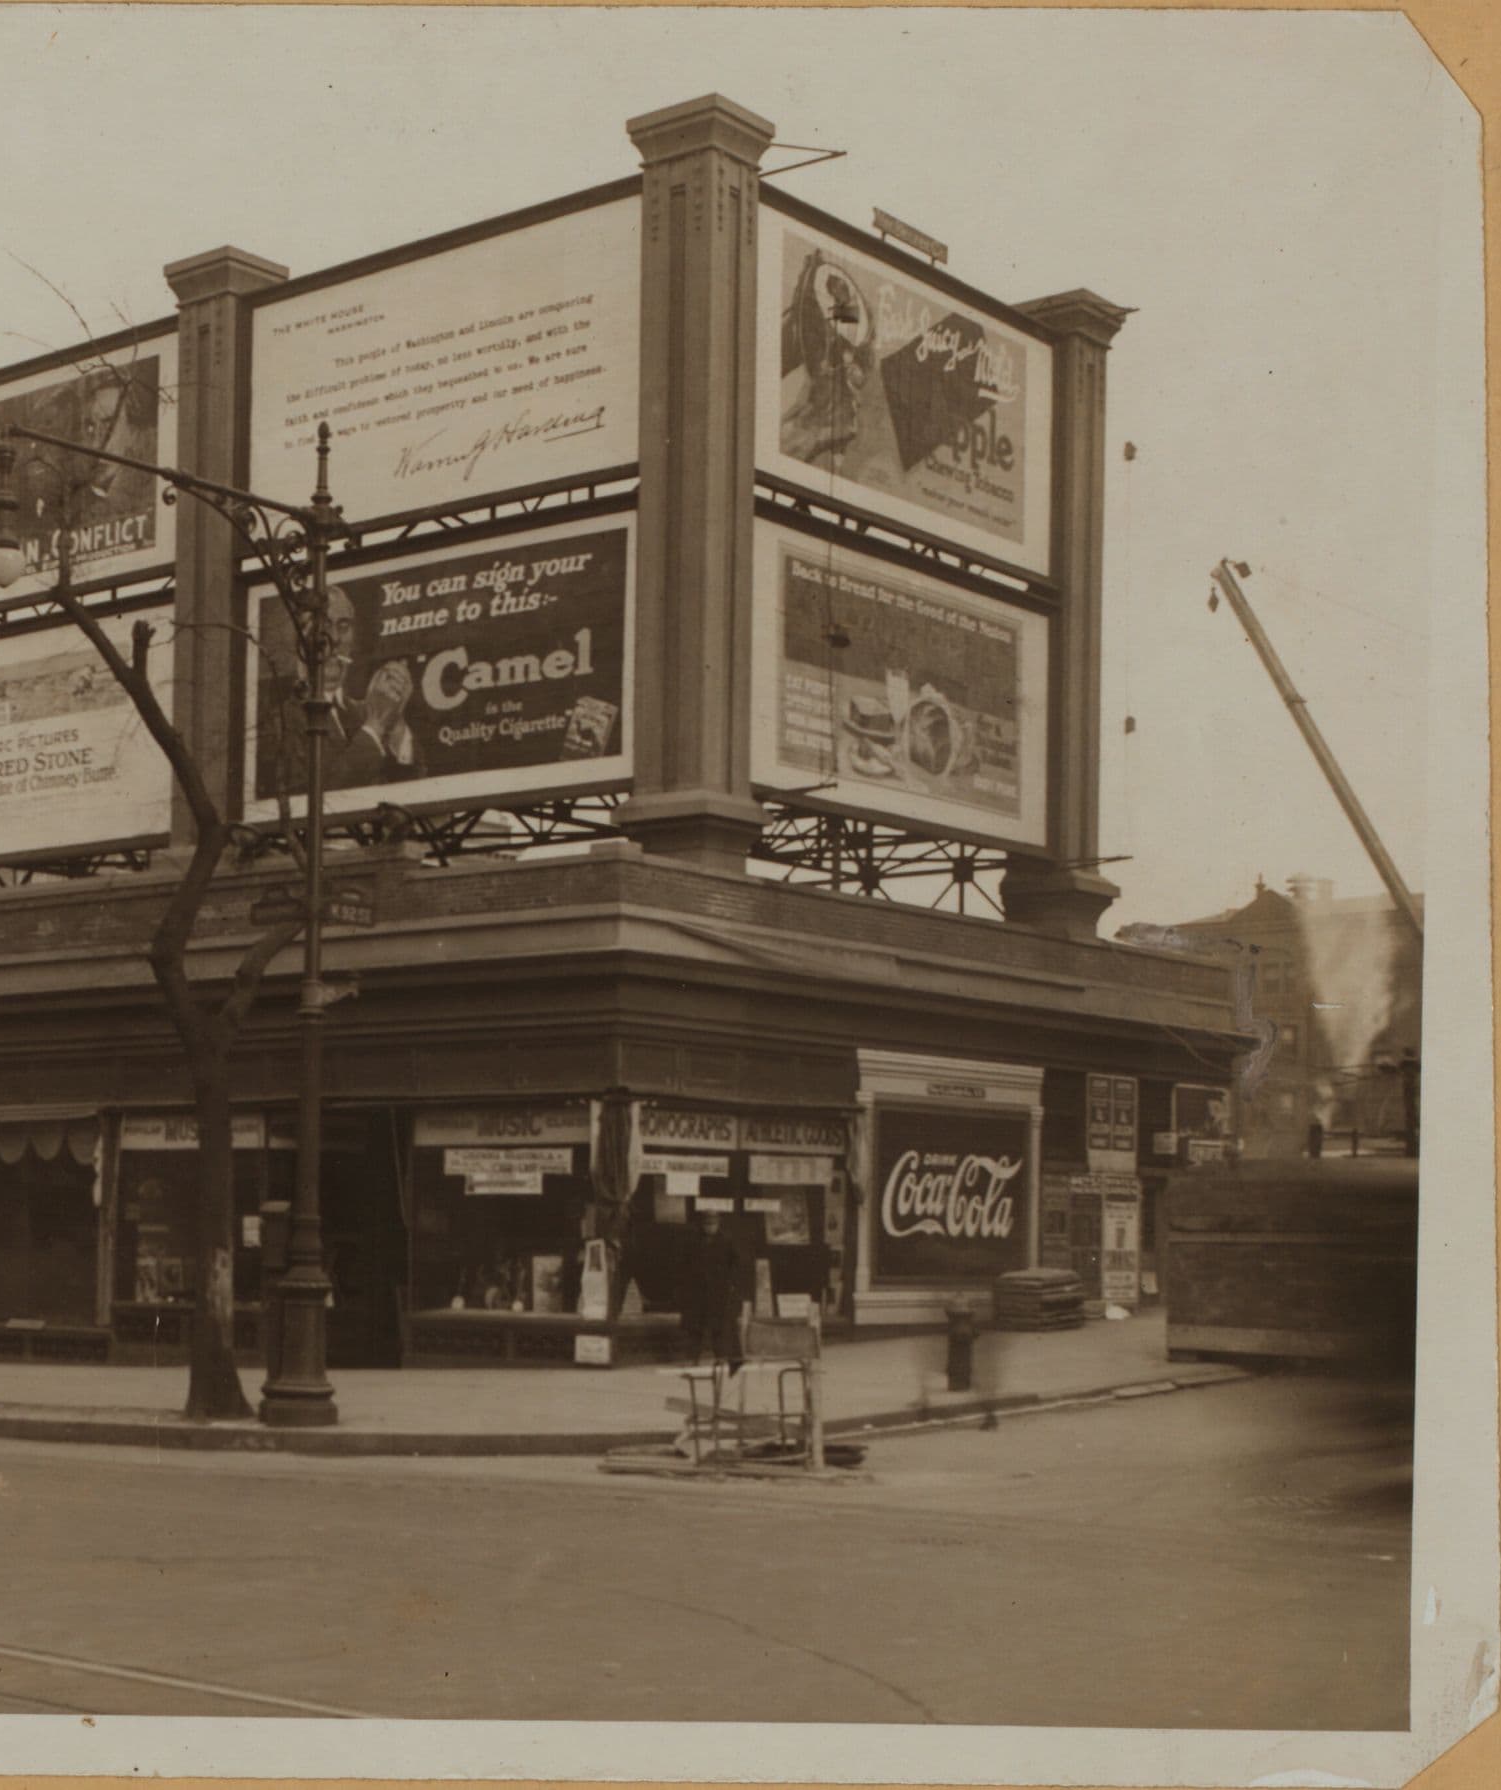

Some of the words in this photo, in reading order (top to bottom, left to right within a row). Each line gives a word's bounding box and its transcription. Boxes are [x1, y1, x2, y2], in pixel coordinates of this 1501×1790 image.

[273, 323, 292, 337] THE
[295, 315, 327, 332] WHITE
[330, 304, 365, 322] HOUSE
[327, 314, 385, 335] WASHINGTON
[334, 356, 355, 369] This
[358, 347, 386, 364] people
[390, 342, 401, 354] of
[405, 329, 455, 351] Washington
[459, 324, 475, 337] and
[478, 314, 514, 332] Lincoln
[518, 311, 535, 322] are
[538, 293, 594, 316] conquering
[286, 392, 301, 404] the
[304, 378, 347, 401] difficult
[390, 365, 401, 377] of
[437, 357, 449, 367] no
[452, 350, 473, 364] less
[525, 331, 542, 345] and
[545, 324, 570, 341] with
[573, 318, 591, 332] the
[284, 413, 309, 428] faith
[312, 407, 330, 420] and
[383, 388, 409, 404] which
[412, 383, 434, 398] they
[528, 354, 541, 366] We
[544, 351, 562, 363] are
[565, 344, 587, 358] sure
[470, 391, 488, 405] and
[538, 377, 550, 391] of
[950, 407, 1015, 473] pple
[380, 581, 421, 608] You
[426, 573, 468, 599] can
[474, 561, 526, 593] sign
[527, 552, 593, 585] your
[791, 559, 823, 585] Back
[839, 573, 877, 600] Bread
[878, 584, 896, 604] for
[896, 588, 915, 611] the
[916, 594, 944, 622] Good
[945, 608, 957, 626] of
[958, 613, 976, 633] the
[380, 605, 449, 637] name
[456, 599, 482, 621] to
[485, 701, 499, 714] is
[501, 698, 523, 714] the
[18, 728, 79, 750] PICTURES
[438, 716, 497, 746] Quality
[499, 711, 566, 741] Cigarette
[33, 747, 93, 774] STONE
[164, 1119, 198, 1142] MUS
[477, 1112, 544, 1137] MUSIC
[640, 1111, 732, 1142] HONOGRAPHS
[922, 1152, 959, 1167] DRINK
